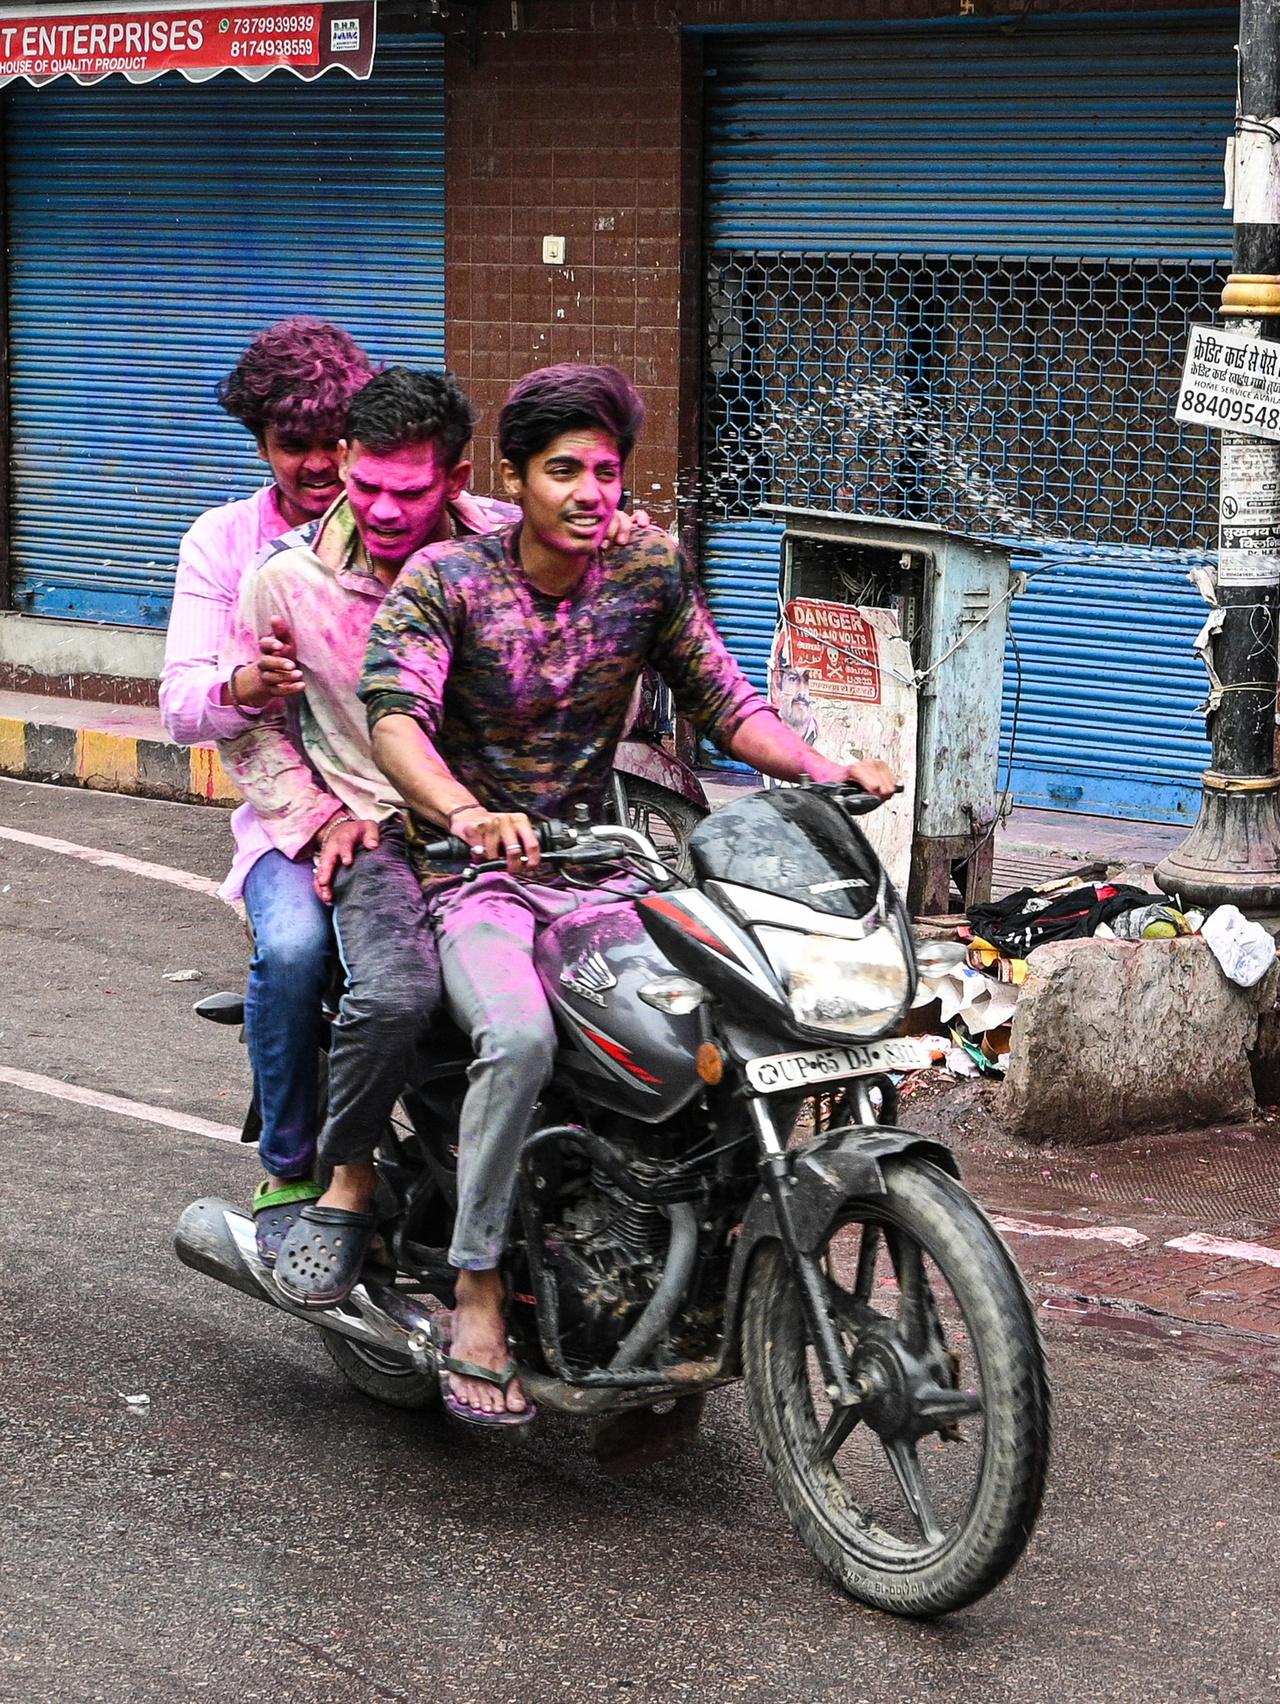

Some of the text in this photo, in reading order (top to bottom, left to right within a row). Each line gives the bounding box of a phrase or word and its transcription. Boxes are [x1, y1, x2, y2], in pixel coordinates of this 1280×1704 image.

[234, 16, 314, 34] 7379939939
[2, 19, 204, 57] T ENTERPRISES
[230, 39, 313, 57] 8174938559
[0, 56, 147, 74] HOUSE OF QUALITY PRODUCT
[1194, 334, 1223, 364] क्रेडिट
[1225, 344, 1249, 369] कार्ड
[1248, 346, 1259, 372] से
[1260, 348, 1278, 376] पैसे
[1190, 361, 1211, 378] क्रेडिट
[1212, 368, 1229, 381] कार्ड
[1194, 380, 1218, 392] HOME
[1220, 385, 1251, 399] SERVICE
[1223, 527, 1270, 540] सुखमय
[794, 606, 865, 632] DANGER
[840, 631, 867, 645] VOLTS
